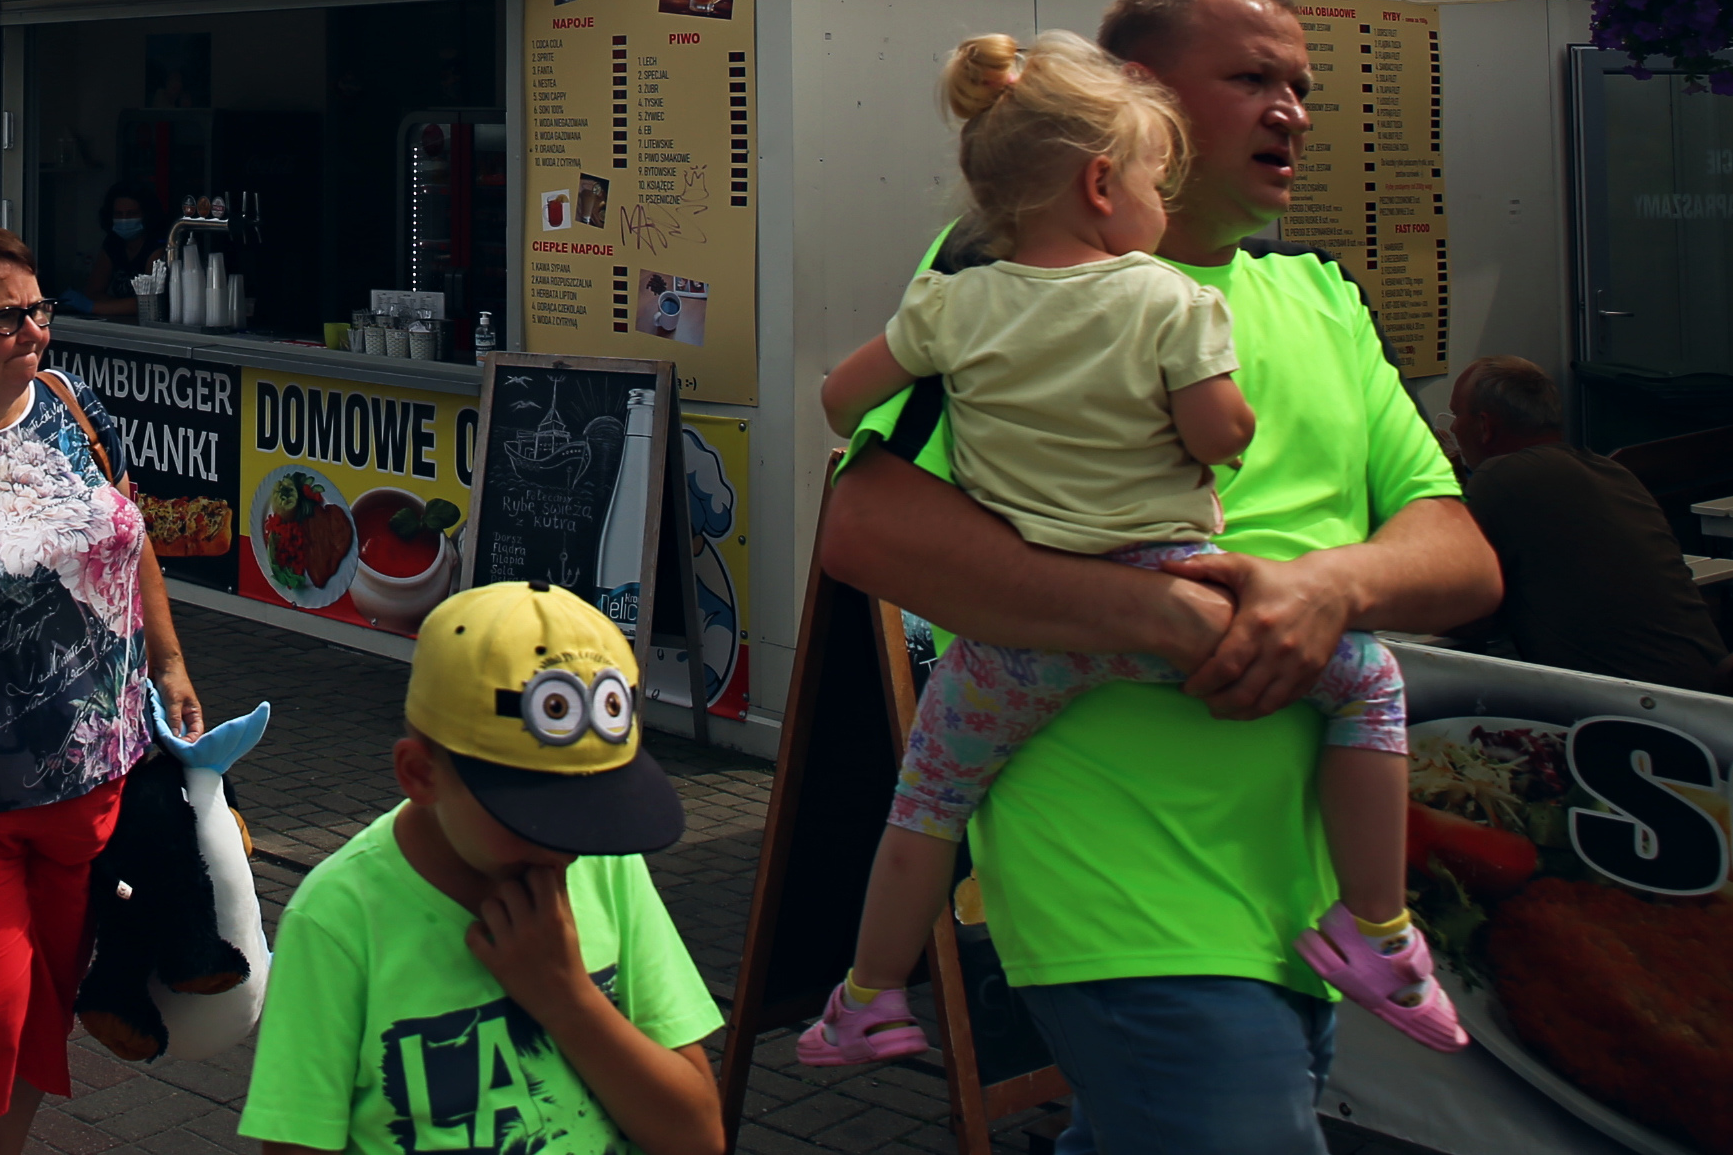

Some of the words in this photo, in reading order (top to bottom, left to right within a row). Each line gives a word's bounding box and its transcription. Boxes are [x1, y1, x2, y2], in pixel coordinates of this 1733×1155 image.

[1315, 6, 1356, 19] OBIADOWE
[1383, 11, 1401, 21] RYBY
[553, 17, 594, 29] NAPOJE
[669, 33, 700, 44] PIWO
[537, 53, 554, 62] SPRITE
[643, 57, 657, 65] LECH
[537, 66, 553, 75] FANTA
[538, 79, 556, 87] NESTEA
[644, 98, 663, 107] TYSKIE
[644, 126, 652, 134] EB
[644, 140, 674, 148] LITEWSKIE
[644, 154, 659, 162] PIWO
[660, 154, 690, 163] SMAKOWE
[644, 167, 676, 176] BYTOWSKIE
[1395, 224, 1411, 234] FAST
[1413, 224, 1430, 234] FOOD
[532, 241, 568, 253] CIEPŁE
[571, 243, 613, 256] NAPOJE
[47, 349, 233, 416] HAMBURGER
[255, 380, 437, 481] DOMOWE
[108, 416, 219, 482] KANKI
[490, 564, 514, 575] Sola
[601, 594, 638, 621] Délic
[399, 1016, 545, 1152] LA
